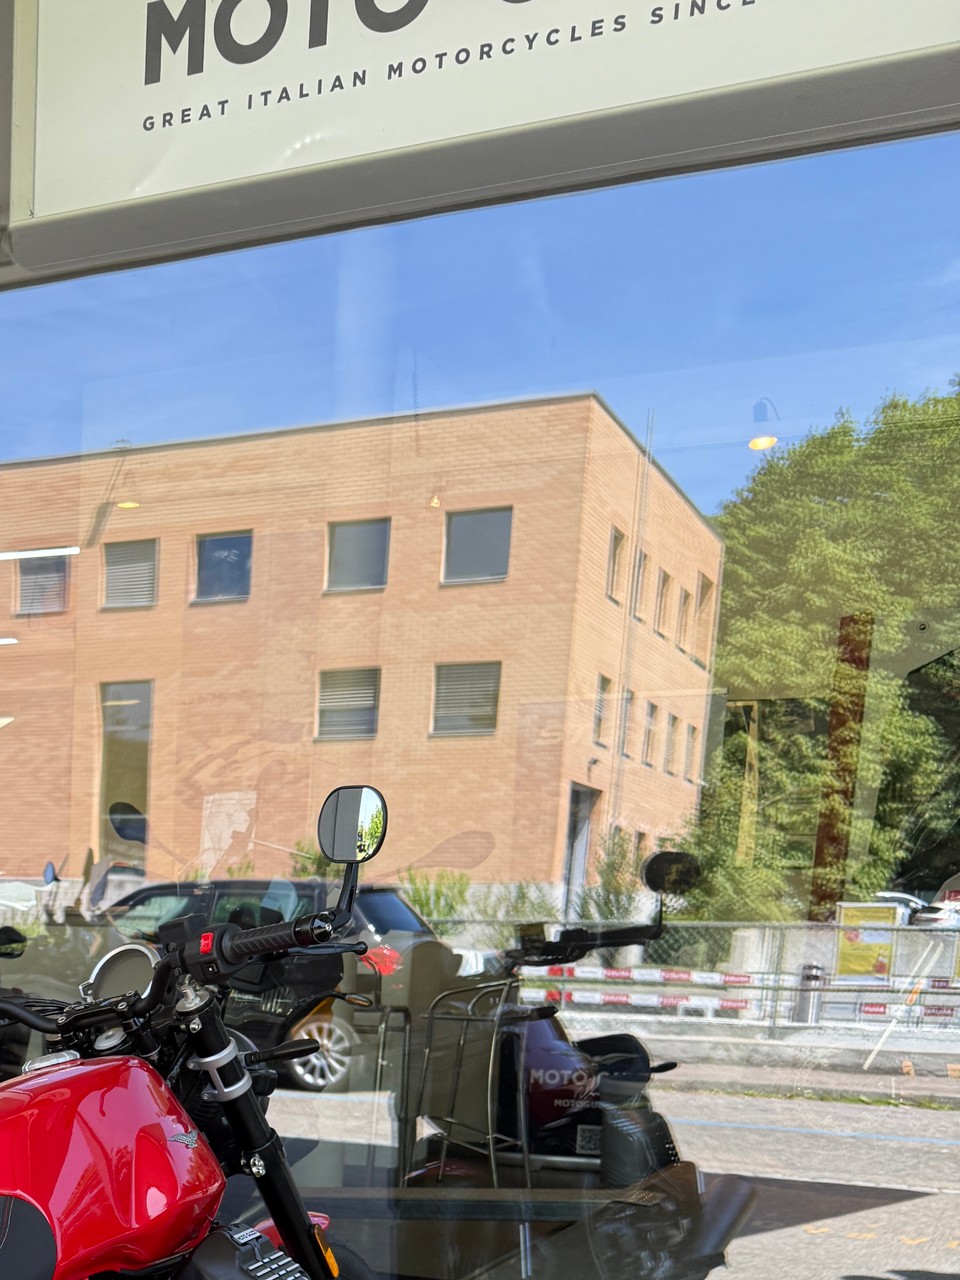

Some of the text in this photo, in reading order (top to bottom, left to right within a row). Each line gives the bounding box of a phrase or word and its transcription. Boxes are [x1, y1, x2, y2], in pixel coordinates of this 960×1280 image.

[142, 99, 229, 132] GREAT
[247, 69, 367, 110] ITALIAN
[386, 14, 627, 80] MOTORCYCLES
